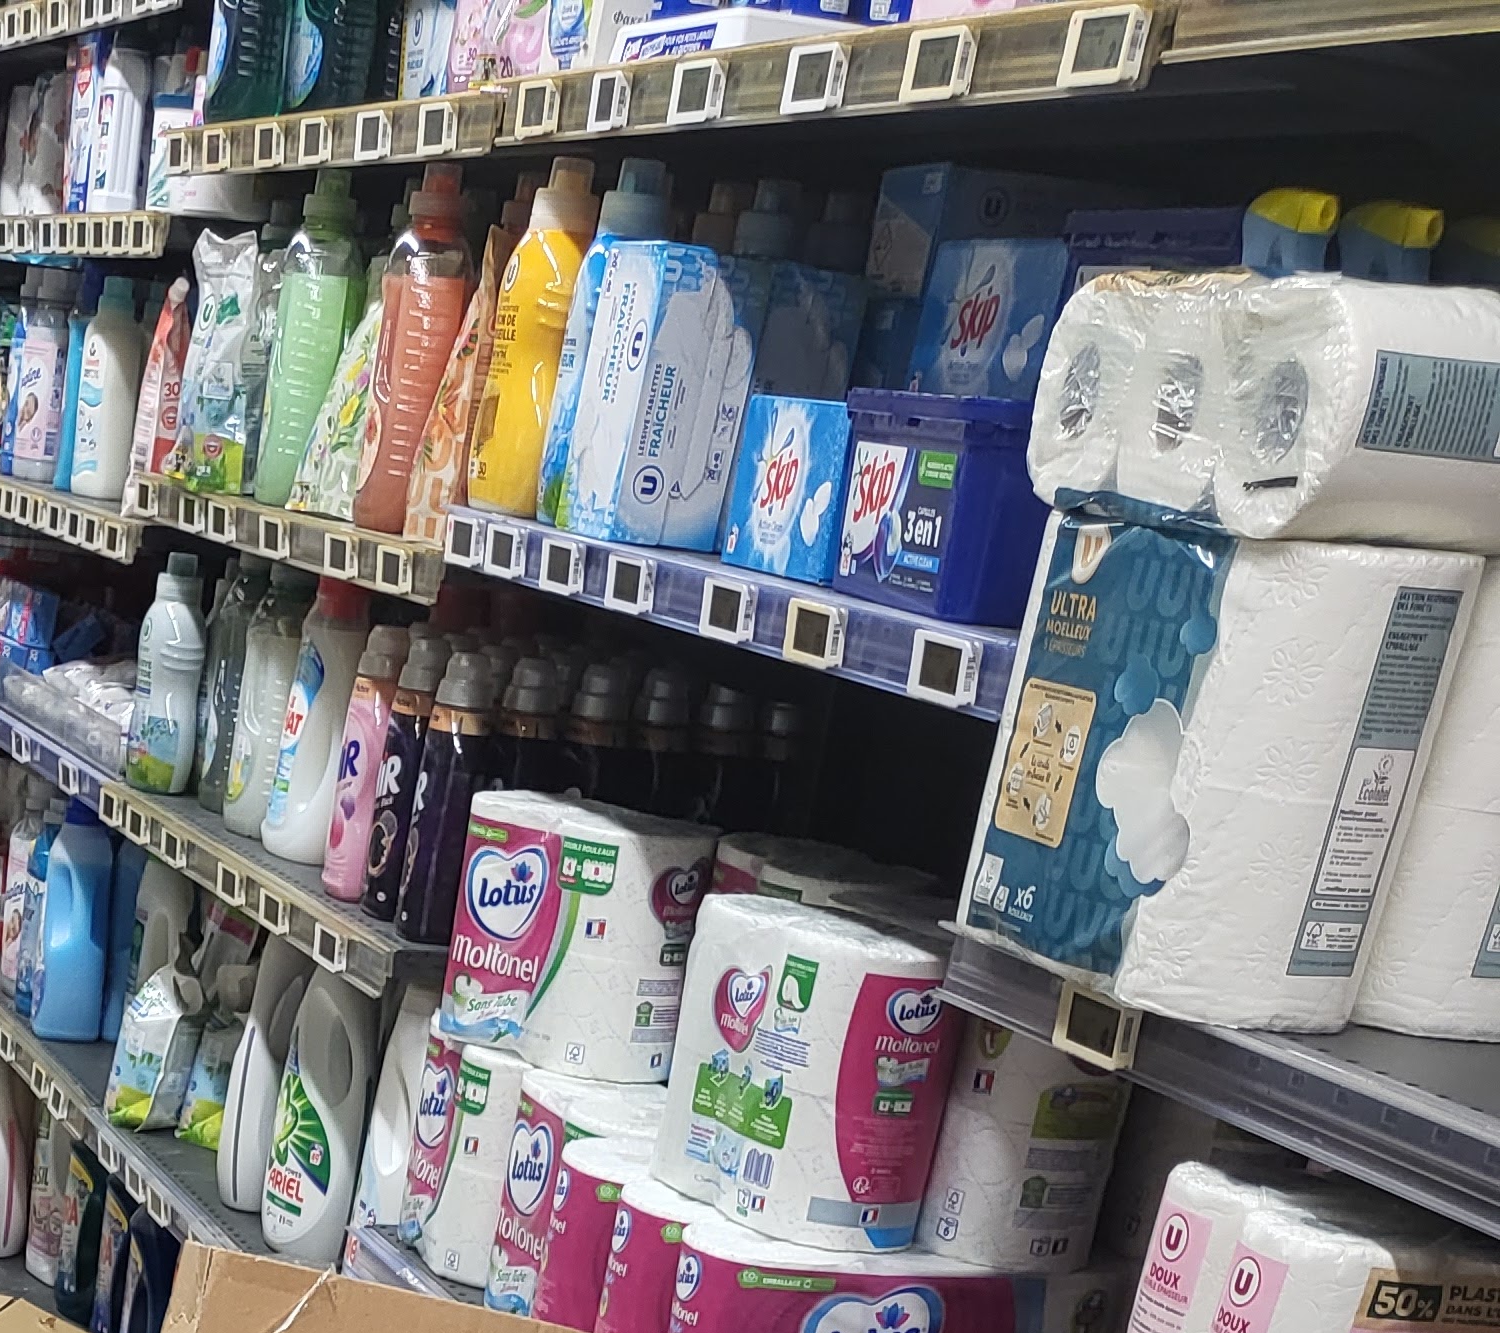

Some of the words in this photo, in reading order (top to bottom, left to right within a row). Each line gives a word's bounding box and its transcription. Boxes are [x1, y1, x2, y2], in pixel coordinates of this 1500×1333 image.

[602, 283, 631, 402] FRAÎCHEUR
[648, 366, 678, 458] FRAÎCHEUR
[1051, 590, 1098, 621] ULTRA
[1045, 618, 1092, 642] MOELLEUX
[479, 878, 539, 907] Lotus
[452, 933, 539, 984] Moltonel
[899, 1003, 937, 1021] Lotus
[269, 1168, 304, 1204] ARIEL
[1150, 1262, 1182, 1290] DOUX
[1374, 1285, 1434, 1319] 50%
[1446, 1305, 1482, 1316] DANS
